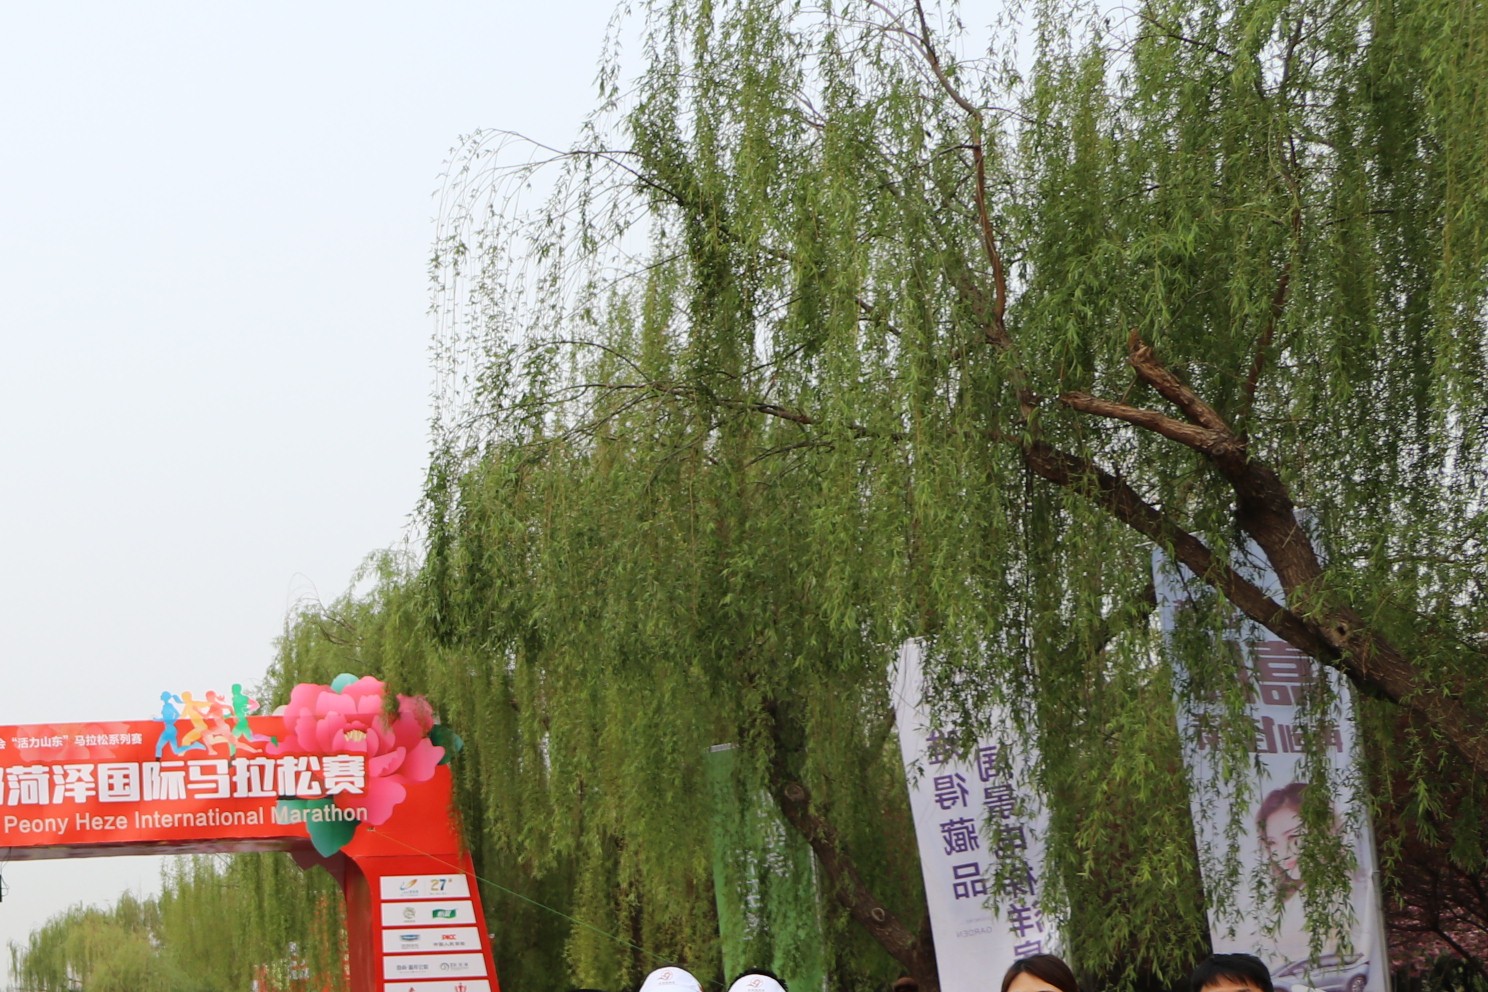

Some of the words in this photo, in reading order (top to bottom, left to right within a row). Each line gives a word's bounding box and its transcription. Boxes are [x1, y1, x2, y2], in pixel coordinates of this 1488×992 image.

[4, 814, 69, 835] Peony
[75, 812, 128, 831] Heze
[135, 806, 264, 828] International
[271, 803, 368, 825] Marathon
